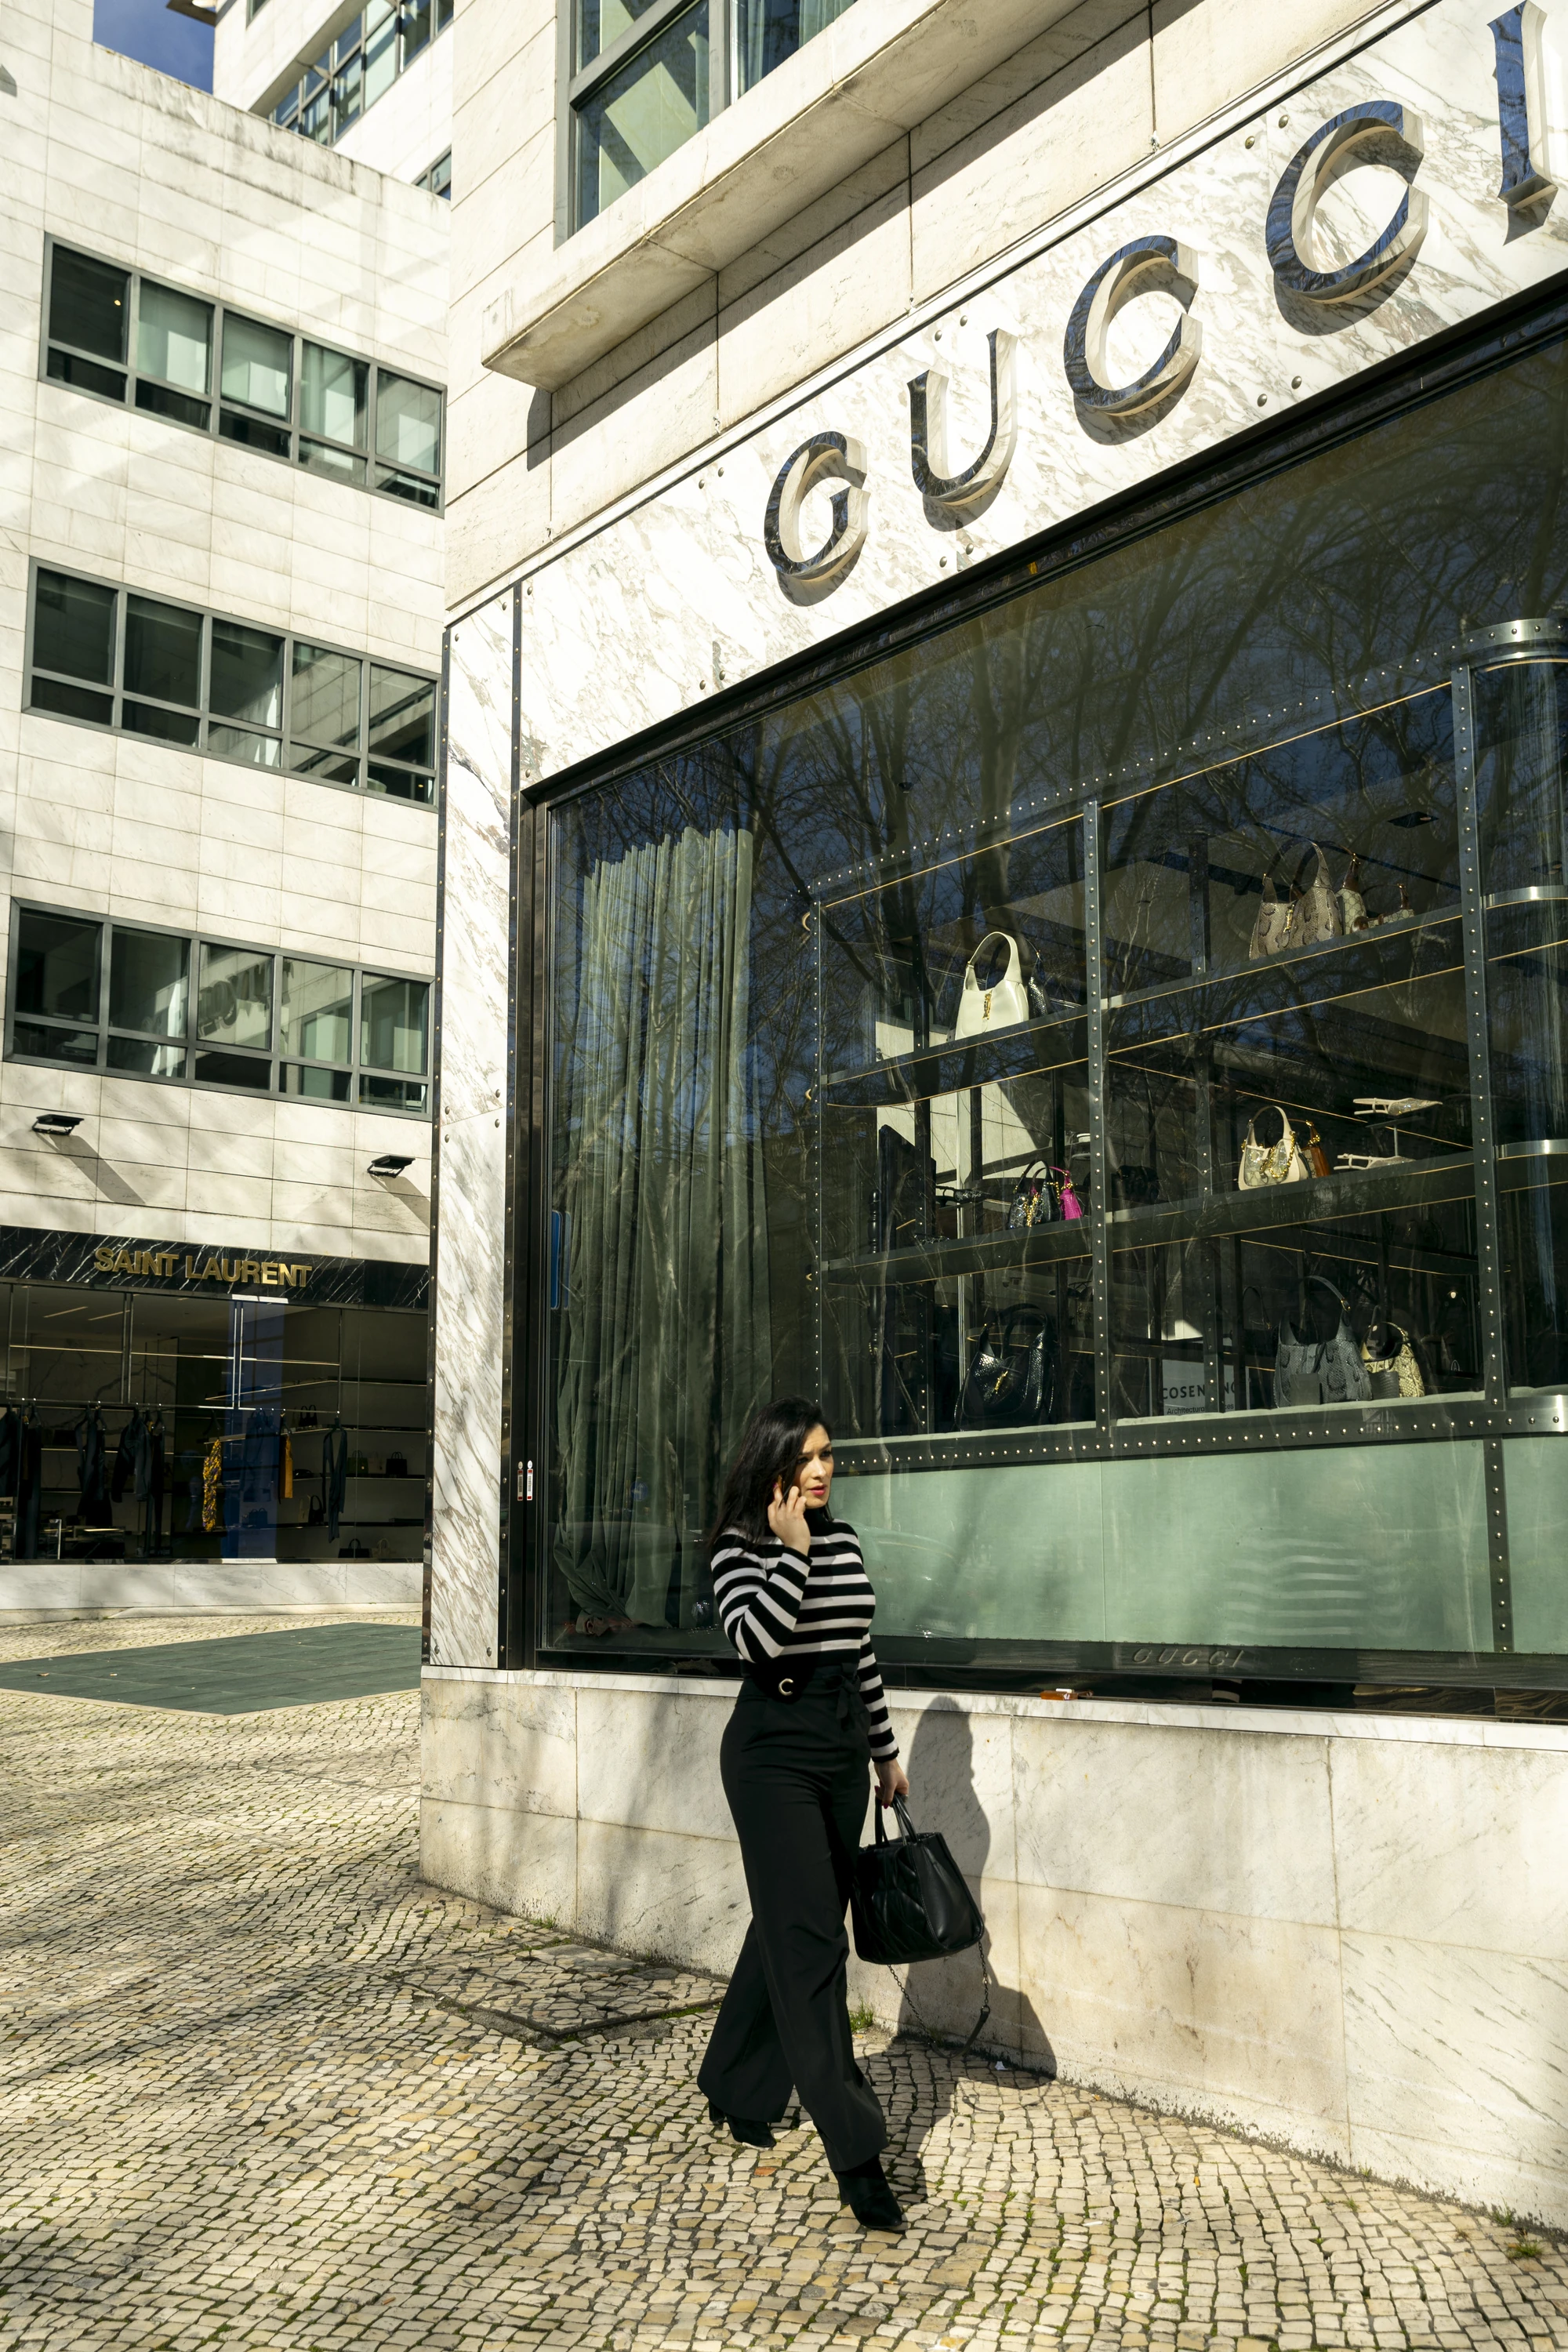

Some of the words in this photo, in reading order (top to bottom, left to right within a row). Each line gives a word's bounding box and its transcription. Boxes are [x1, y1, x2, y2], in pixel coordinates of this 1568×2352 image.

[764, 0, 1557, 582] GUCCI
[94, 1247, 179, 1277] SAINT
[185, 1255, 312, 1287] LAURENT
[1133, 1648, 1244, 1668] GUCCI
